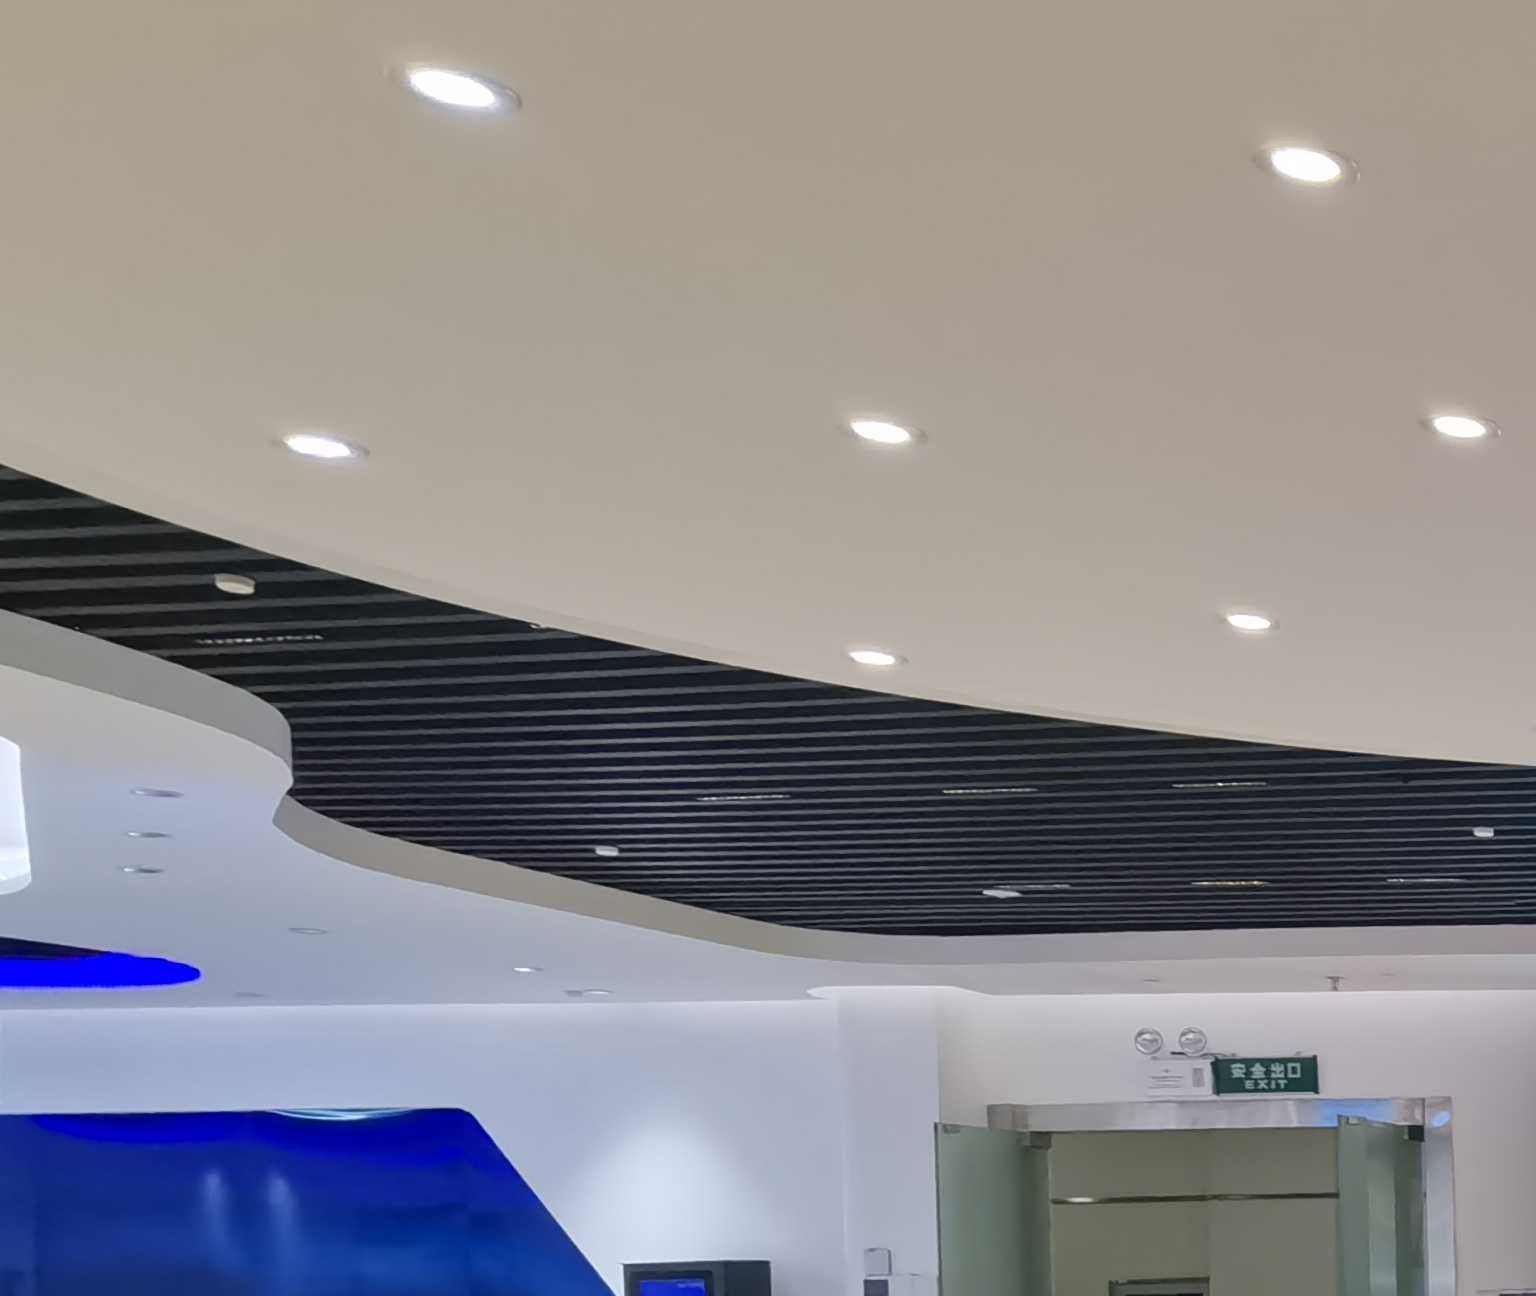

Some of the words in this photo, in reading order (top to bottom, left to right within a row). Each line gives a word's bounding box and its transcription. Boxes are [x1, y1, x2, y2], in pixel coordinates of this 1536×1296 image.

[1230, 1062, 1302, 1079] 安全出口
[1244, 1079, 1289, 1090] EXIT
